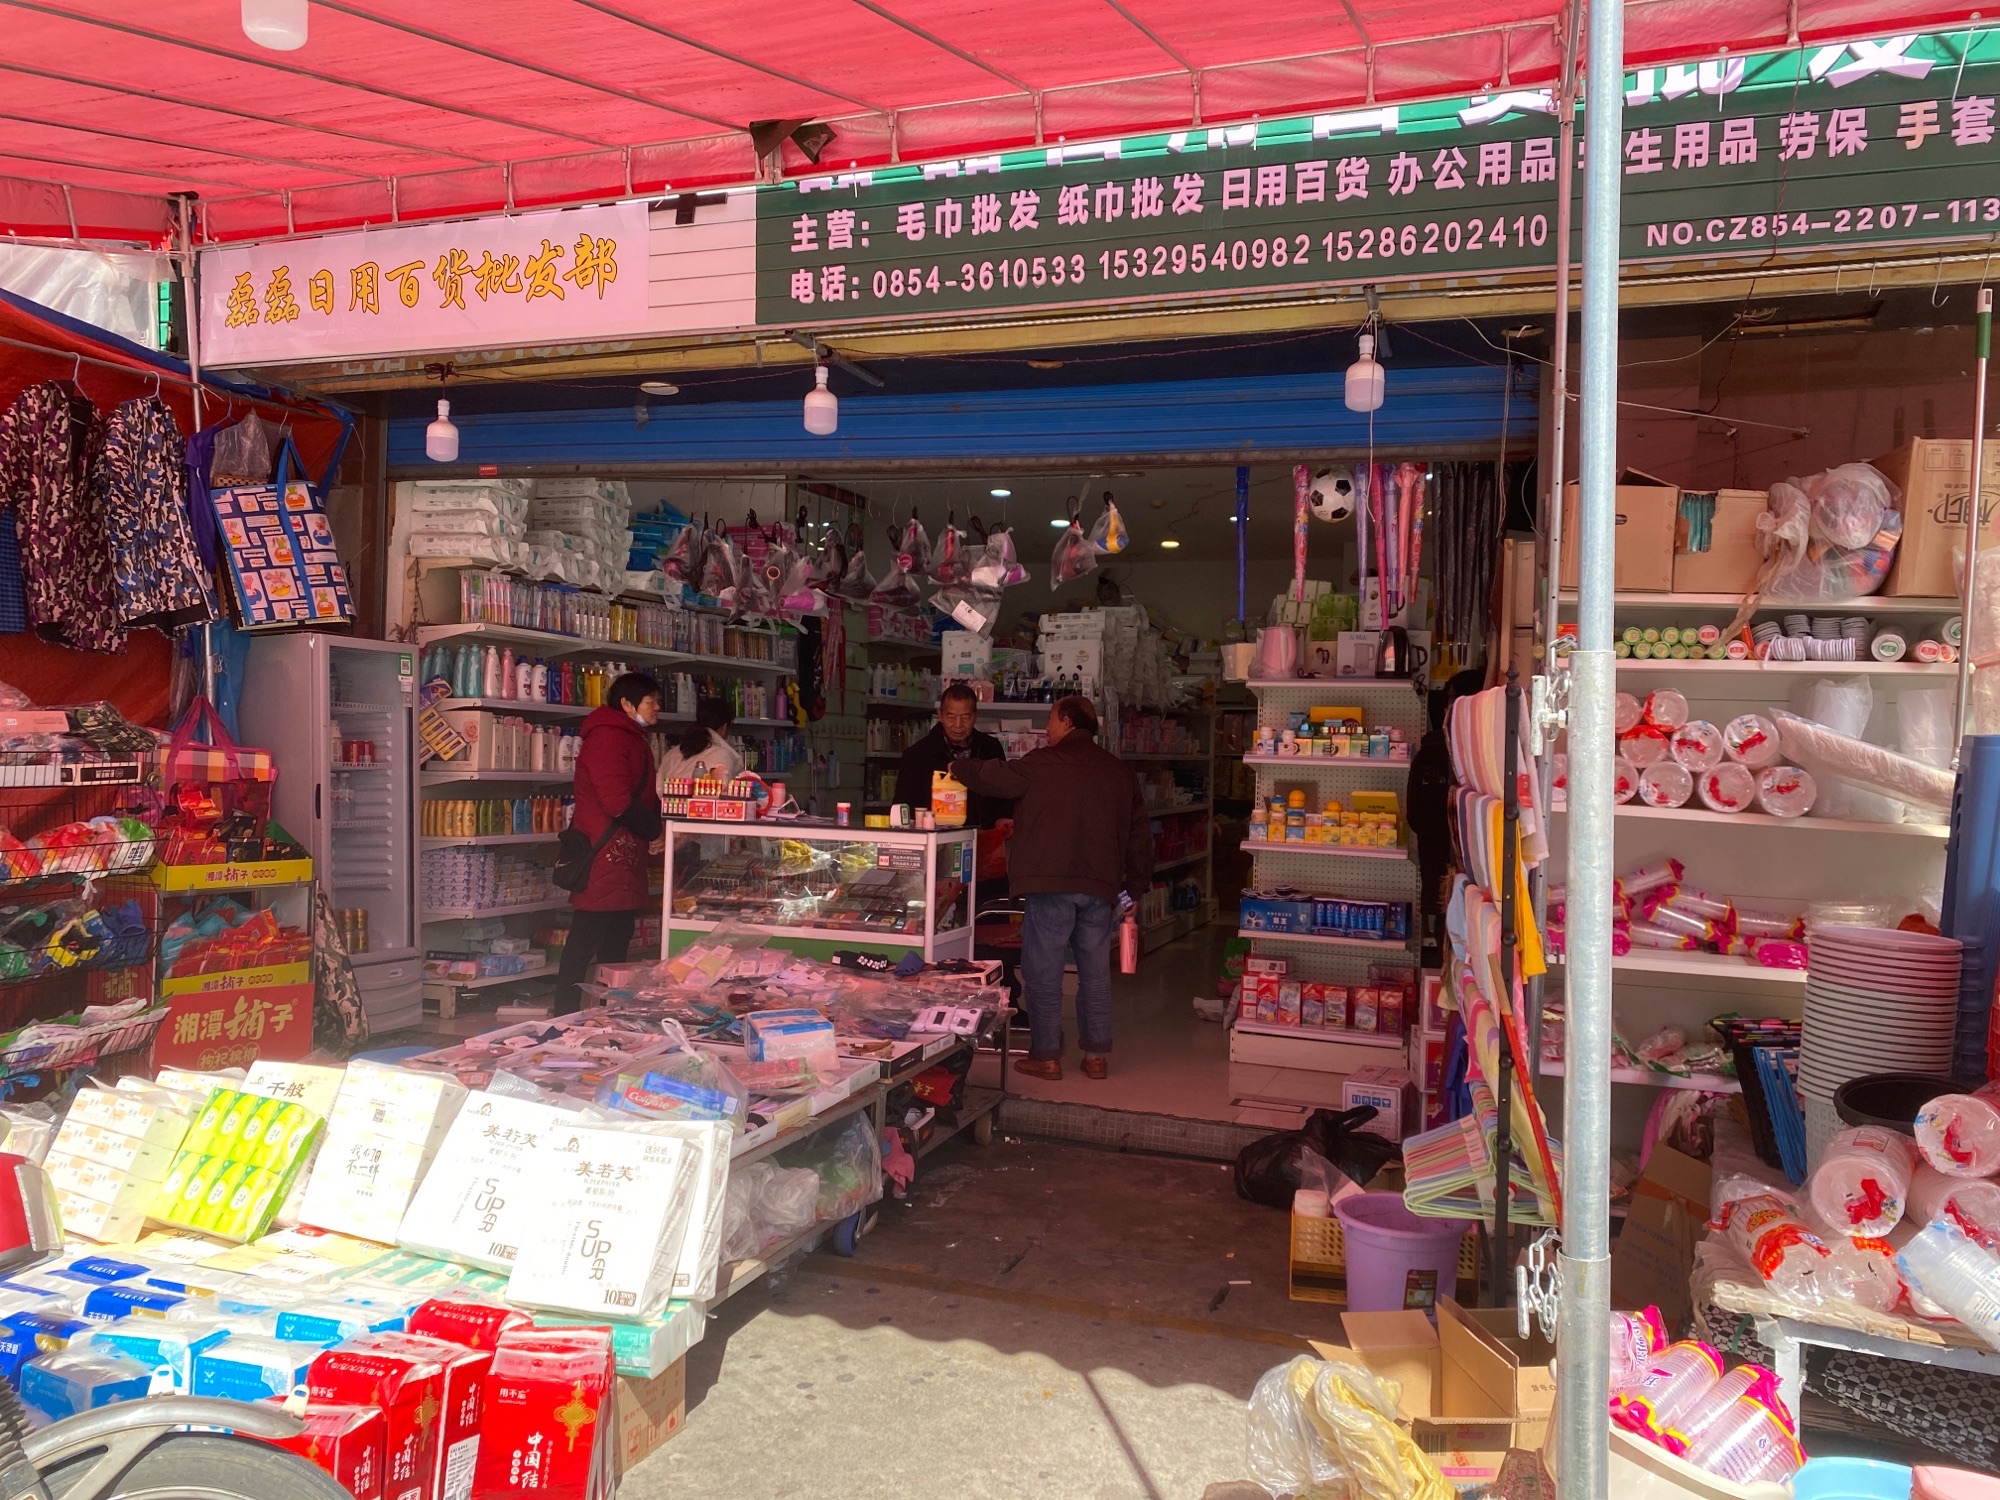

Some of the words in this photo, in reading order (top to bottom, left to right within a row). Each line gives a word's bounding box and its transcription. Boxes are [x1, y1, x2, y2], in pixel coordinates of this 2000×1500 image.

[896, 189, 1041, 240] 毛巾批发
[1057, 172, 1205, 226] 纸巾批发
[1222, 157, 1370, 210] 日用百货
[1389, 137, 1556, 196] 办公用品
[1779, 107, 1868, 162] 劳保
[1897, 95, 1996, 150] 手套
[873, 254, 1087, 299] 0854-3610533
[1099, 234, 1310, 280] 15329540982
[1321, 214, 1548, 264] 15286202410
[224, 233, 618, 328] 磊磊日用百货批发部
[205, 866, 248, 882] 湘潭铺子
[201, 975, 245, 992] 湘潭铺子
[172, 995, 294, 1045] 湘潭铺子
[266, 1081, 306, 1098] 千般
[629, 1092, 670, 1109] Colgate
[575, 1160, 634, 1182] 美若芙
[603, 1289, 618, 1305] 10
[499, 1388, 526, 1399] 用不忘
[522, 1432, 544, 1489] 中国结
